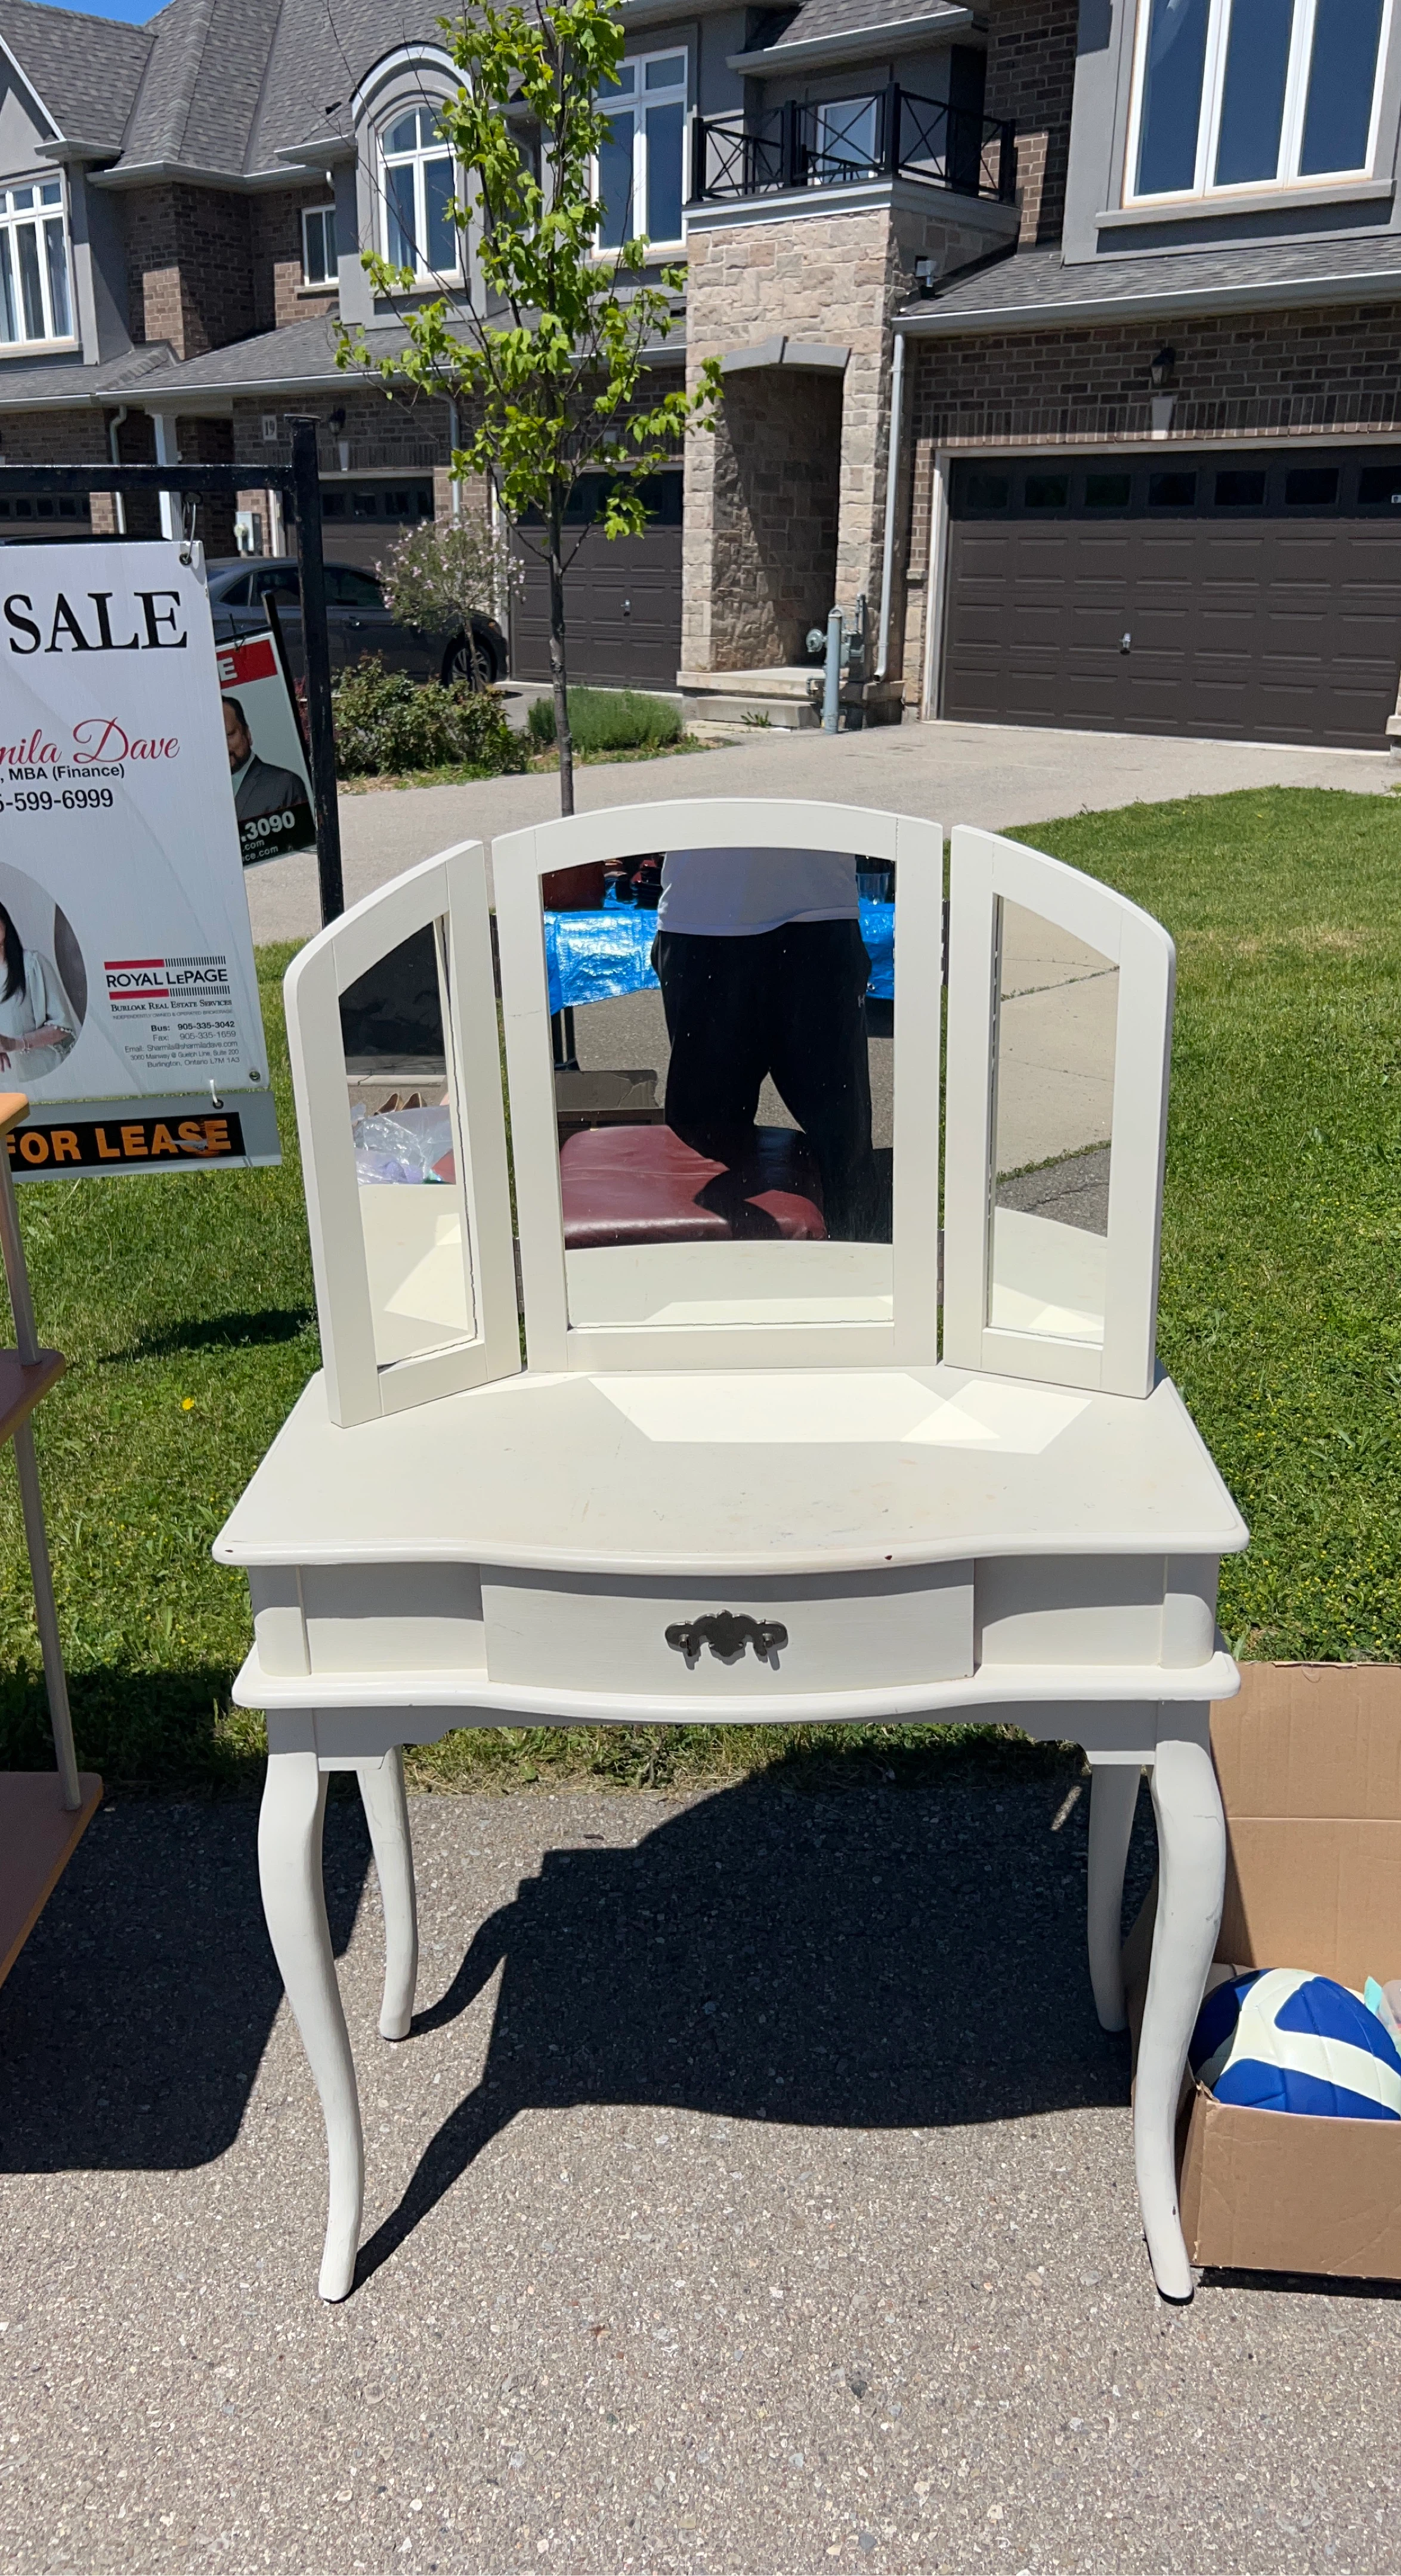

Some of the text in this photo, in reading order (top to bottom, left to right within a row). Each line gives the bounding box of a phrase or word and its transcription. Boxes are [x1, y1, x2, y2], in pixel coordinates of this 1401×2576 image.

[4, 592, 187, 654] SALE
[73, 717, 180, 764] Dave
[9, 767, 48, 781] MBA
[52, 763, 125, 781] (Finance)
[241, 811, 295, 842] .3090
[106, 973, 163, 987] ROYAL
[178, 1021, 235, 1030] 905-335-3042
[180, 1030, 236, 1040] 905-335-1659
[95, 1119, 232, 1159] LEASE
